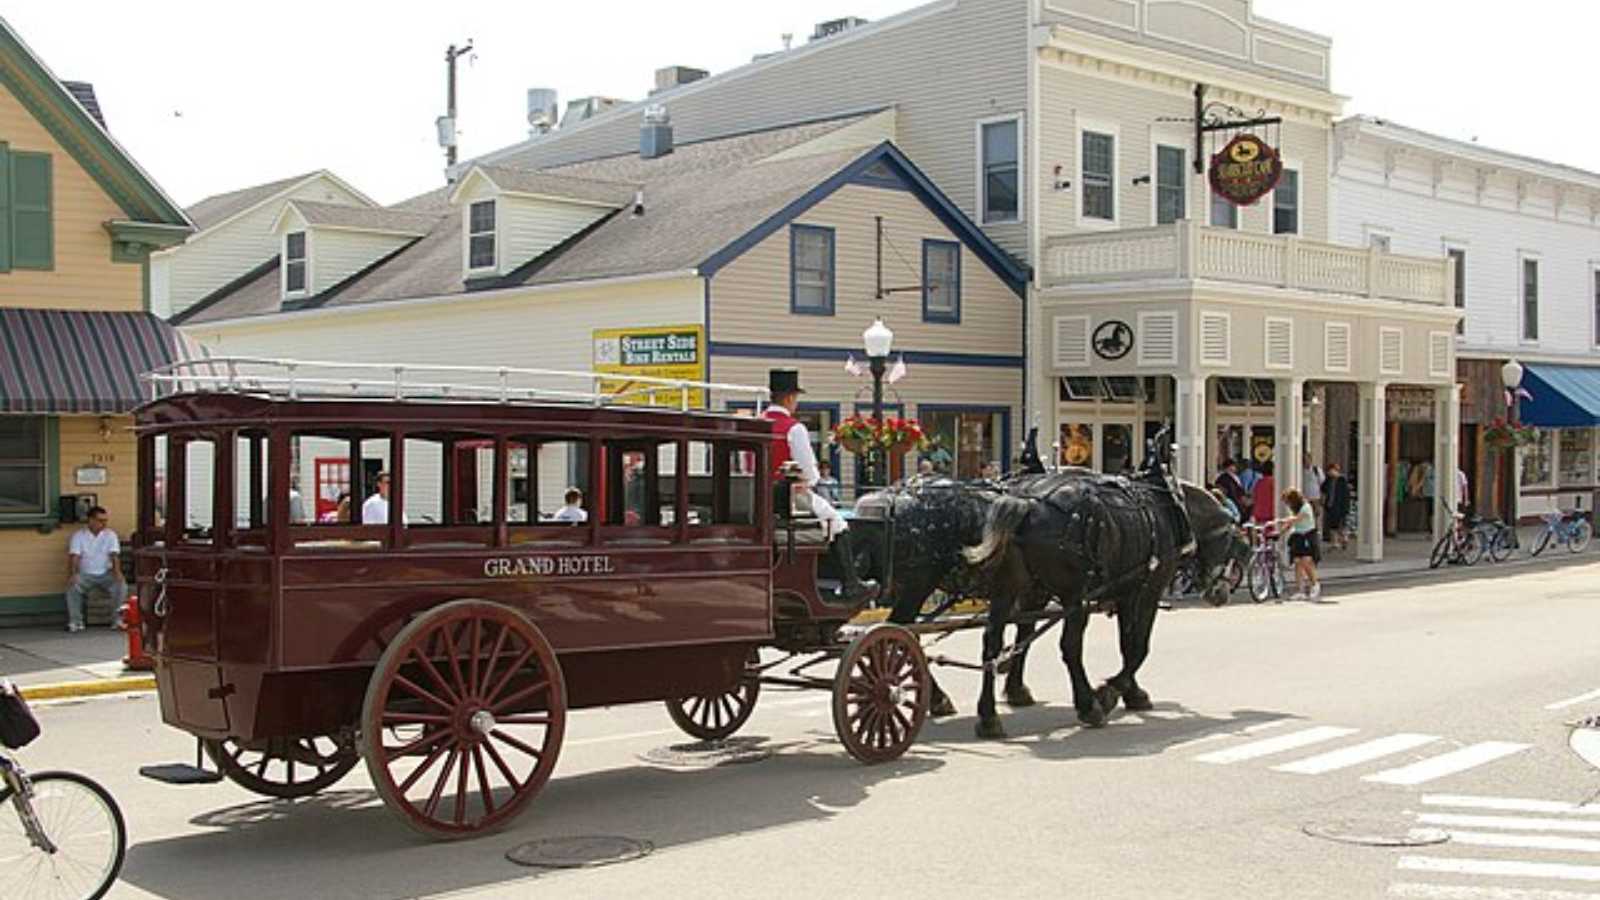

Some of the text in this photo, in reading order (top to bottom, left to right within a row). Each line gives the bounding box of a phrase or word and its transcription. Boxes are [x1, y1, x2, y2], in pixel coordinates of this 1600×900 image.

[622, 335, 696, 352] STREET SIDE
[625, 351, 696, 364] BIKE RENTALS
[484, 556, 615, 577] GRAND HOTEL
